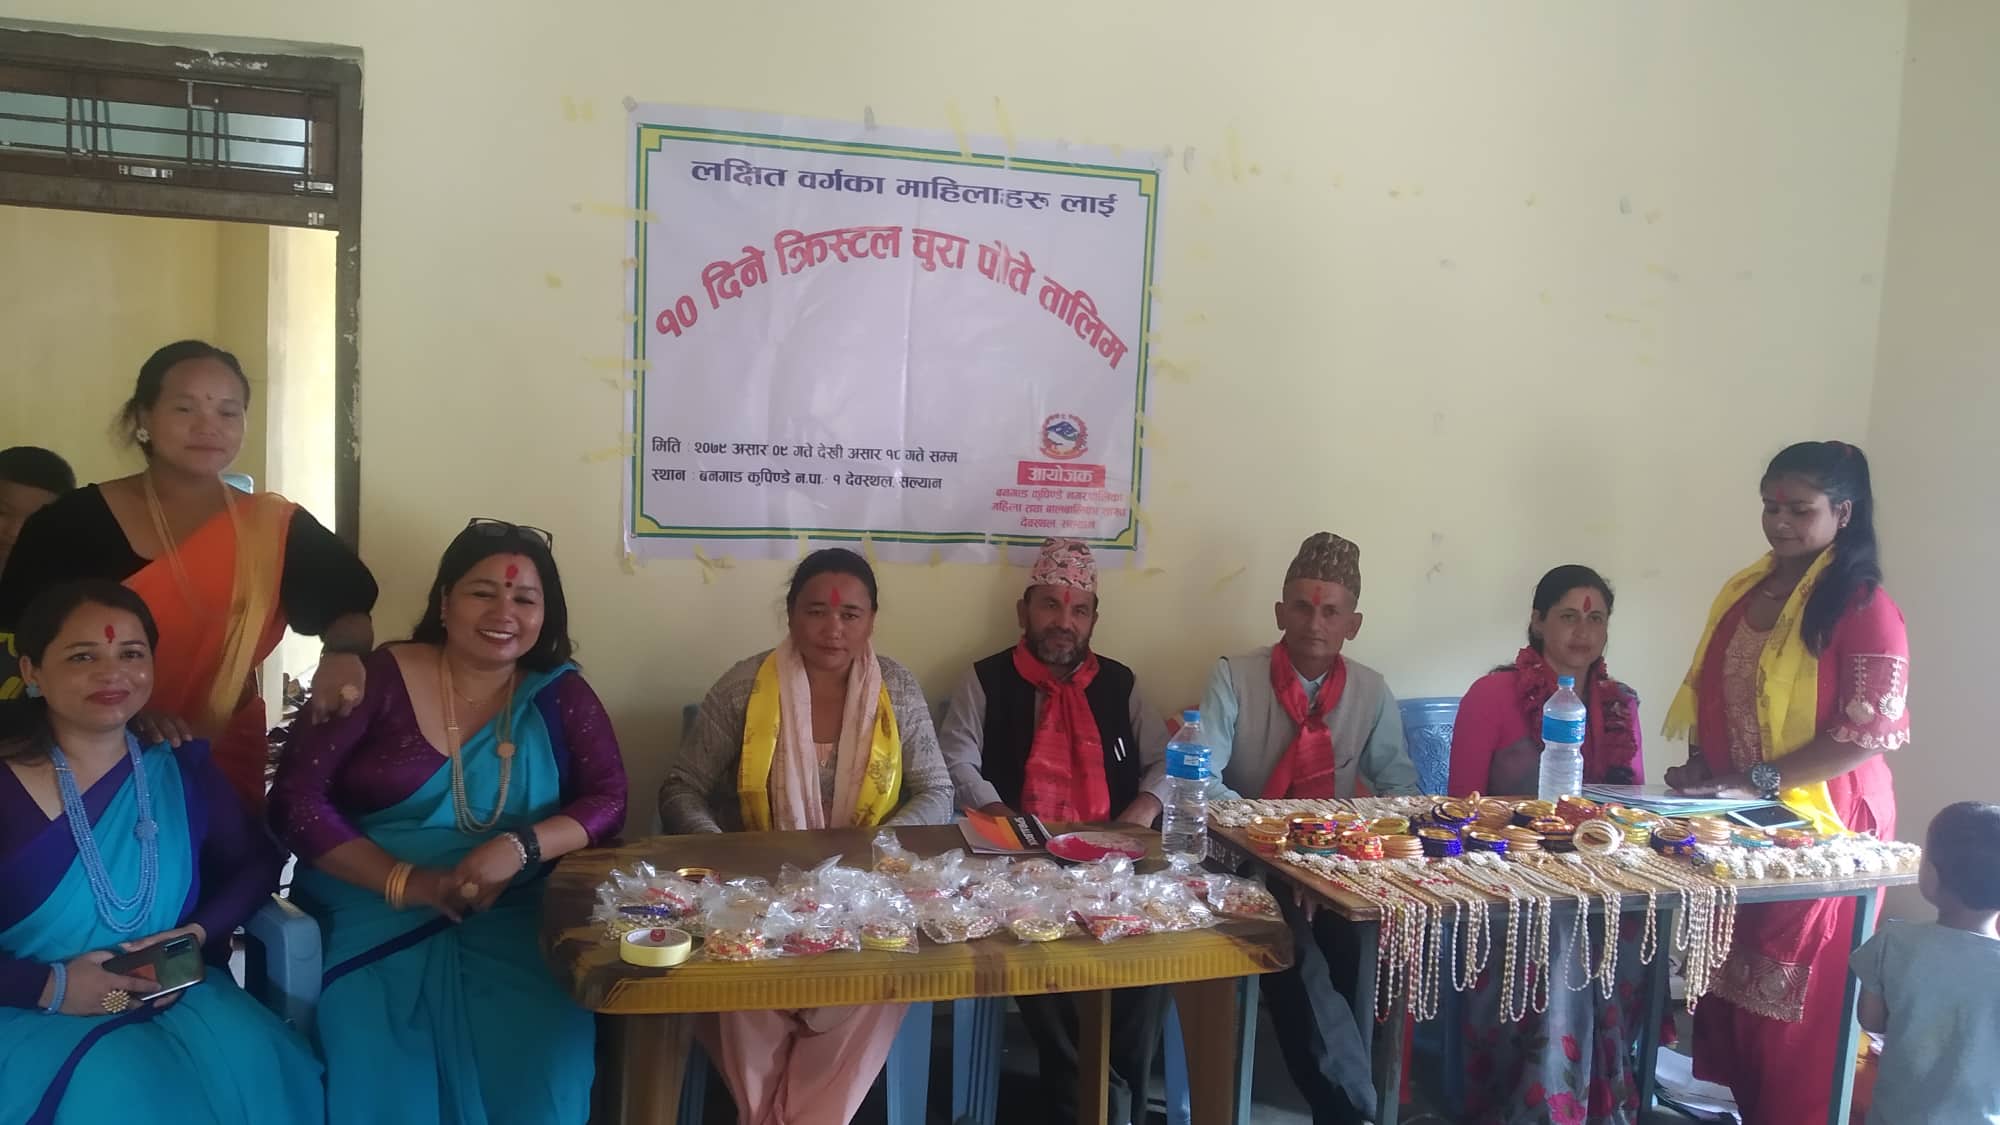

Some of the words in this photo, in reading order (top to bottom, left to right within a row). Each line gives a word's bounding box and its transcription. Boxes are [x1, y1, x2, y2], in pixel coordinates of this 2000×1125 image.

[691, 158, 788, 187] लक्षित
[798, 168, 886, 194] वर्गका
[1060, 193, 1119, 218] लाई
[655, 295, 698, 337] १०
[701, 246, 768, 310] दिने
[774, 226, 903, 275] क्रिस्टल
[911, 228, 970, 272] चुरा
[1038, 276, 1128, 370] तालिम
[652, 436, 682, 454] मिति
[694, 442, 727, 454] २०७९
[732, 443, 769, 457] असार
[772, 444, 788, 457] ०९
[792, 442, 814, 458] गते
[847, 447, 884, 461] असार
[905, 446, 926, 462] गते
[929, 450, 959, 463] सम्म
[651, 468, 687, 482] स्थान
[699, 470, 744, 483] बनगाड
[833, 474, 841, 485] १
[899, 476, 943, 489] सल्यान
[1028, 464, 1095, 482] आयोजक
